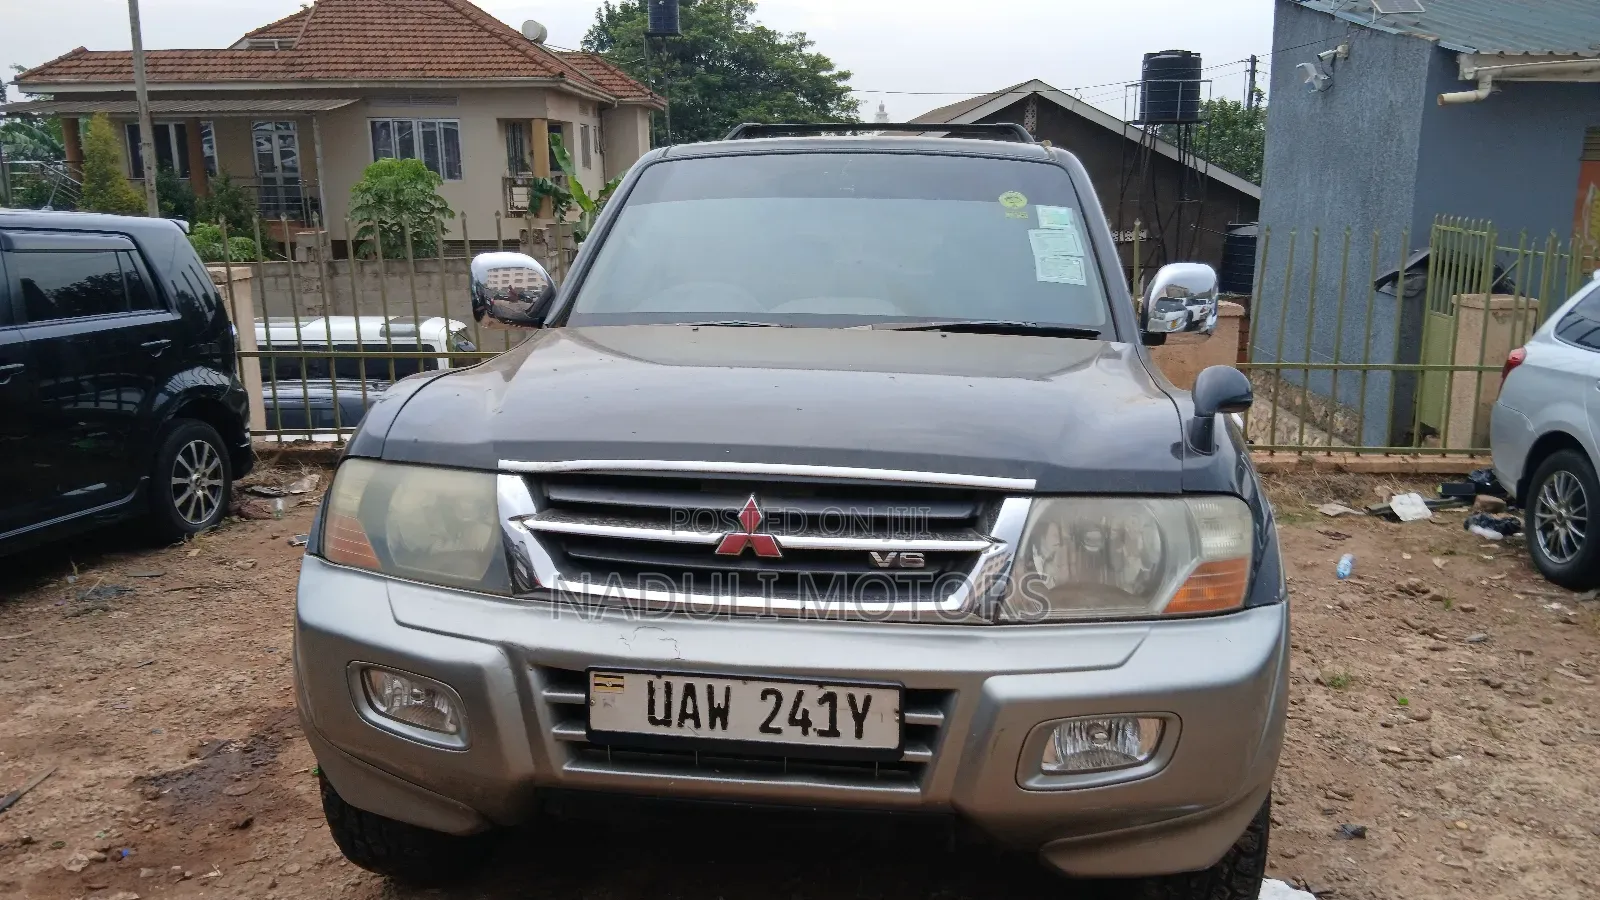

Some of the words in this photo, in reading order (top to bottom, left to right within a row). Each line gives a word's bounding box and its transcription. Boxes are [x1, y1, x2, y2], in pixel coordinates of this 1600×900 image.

[870, 551, 925, 568] V6
[647, 680, 731, 731] UAW
[759, 687, 873, 739] 241Y
